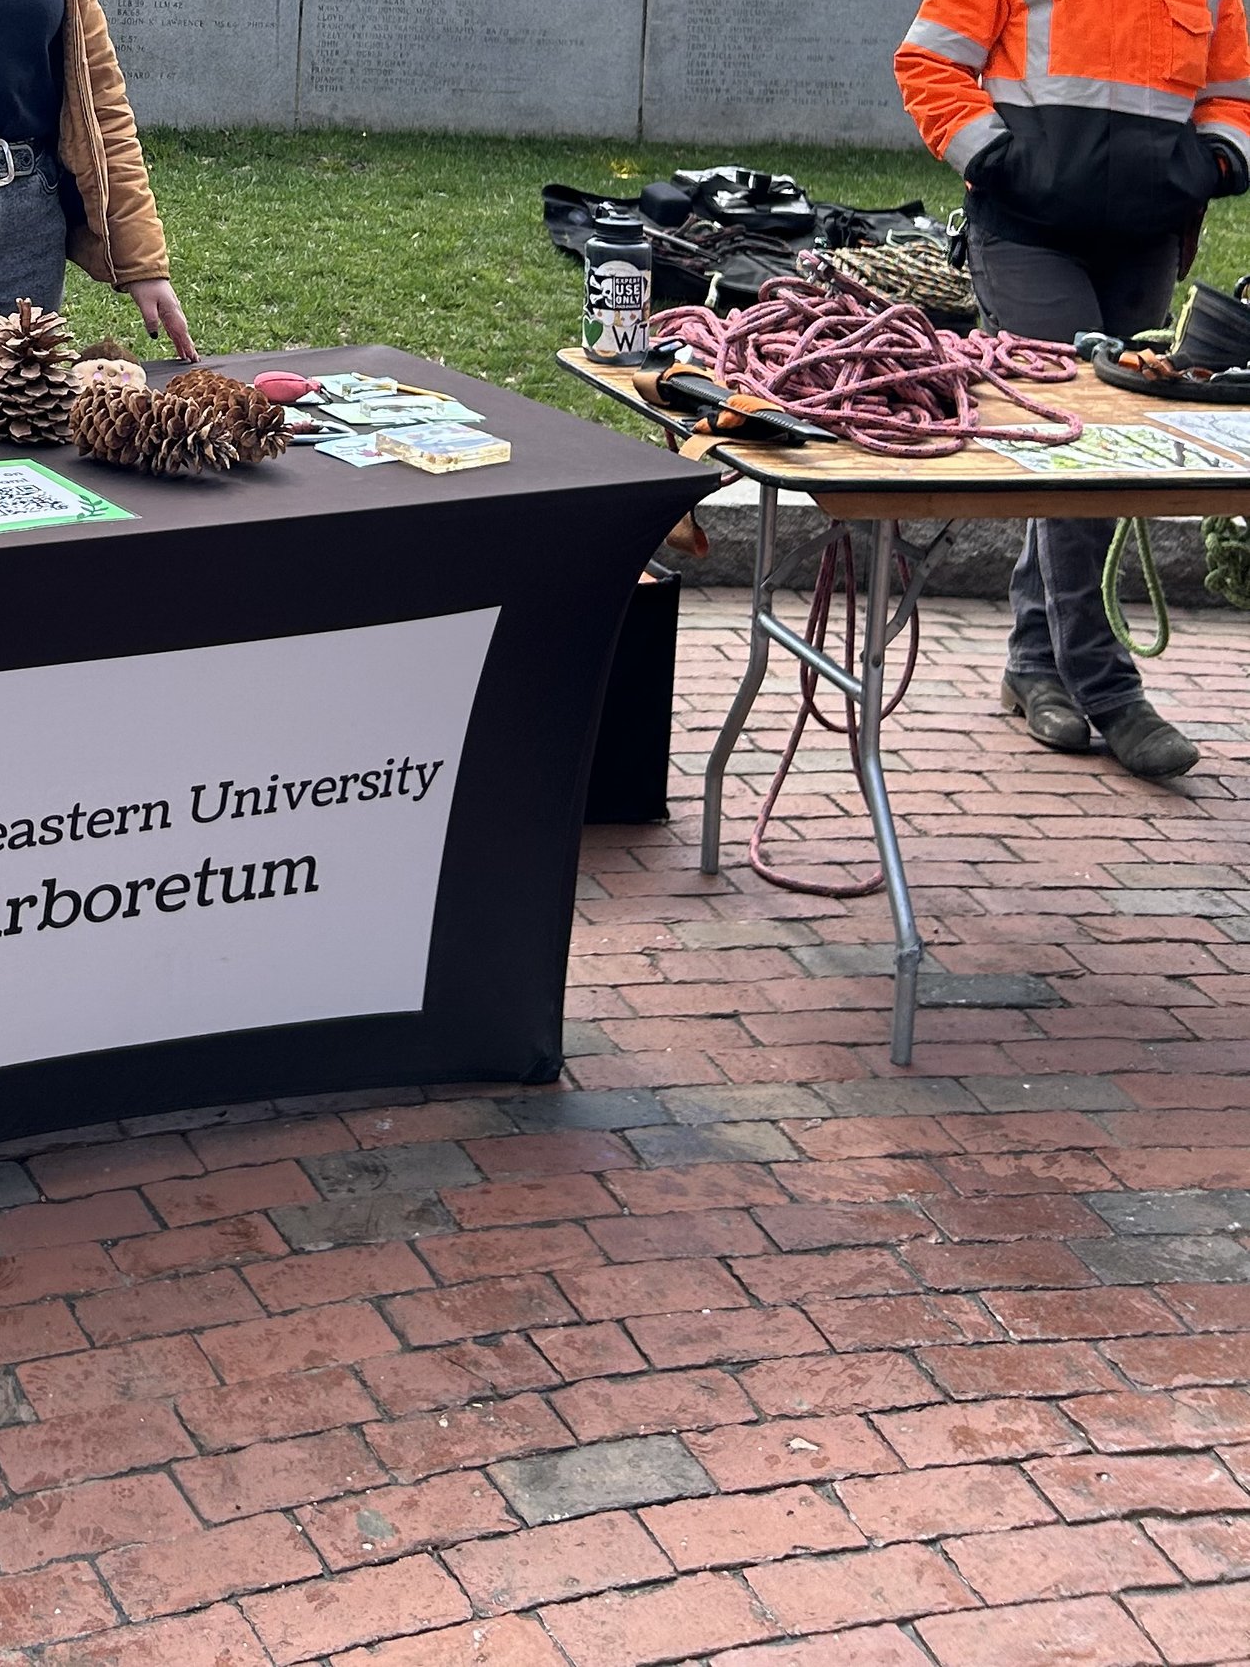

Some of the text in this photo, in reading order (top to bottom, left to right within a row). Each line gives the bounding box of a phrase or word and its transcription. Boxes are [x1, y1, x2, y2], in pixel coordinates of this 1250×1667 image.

[161, 19, 204, 27] LAWRENCE
[615, 284, 640, 296] USE
[615, 295, 640, 305] ONLY
[190, 757, 444, 823] University
